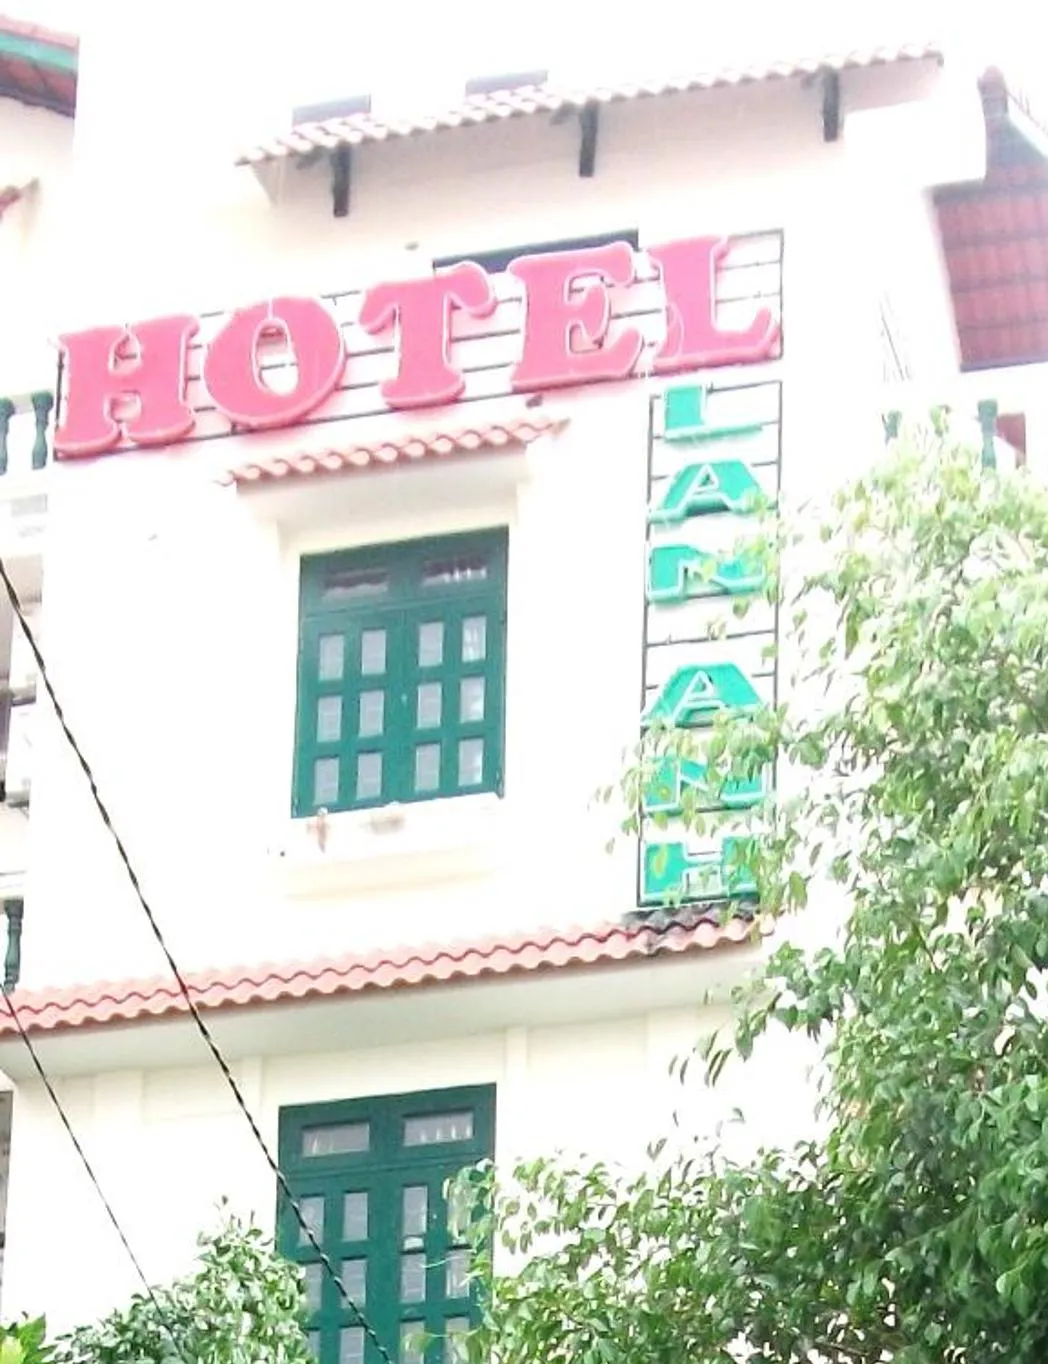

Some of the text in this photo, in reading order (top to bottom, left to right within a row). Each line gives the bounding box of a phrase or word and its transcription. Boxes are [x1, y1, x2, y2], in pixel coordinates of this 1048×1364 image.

[54, 236, 783, 458] HOTEL
[640, 384, 768, 900] LAN ANH
